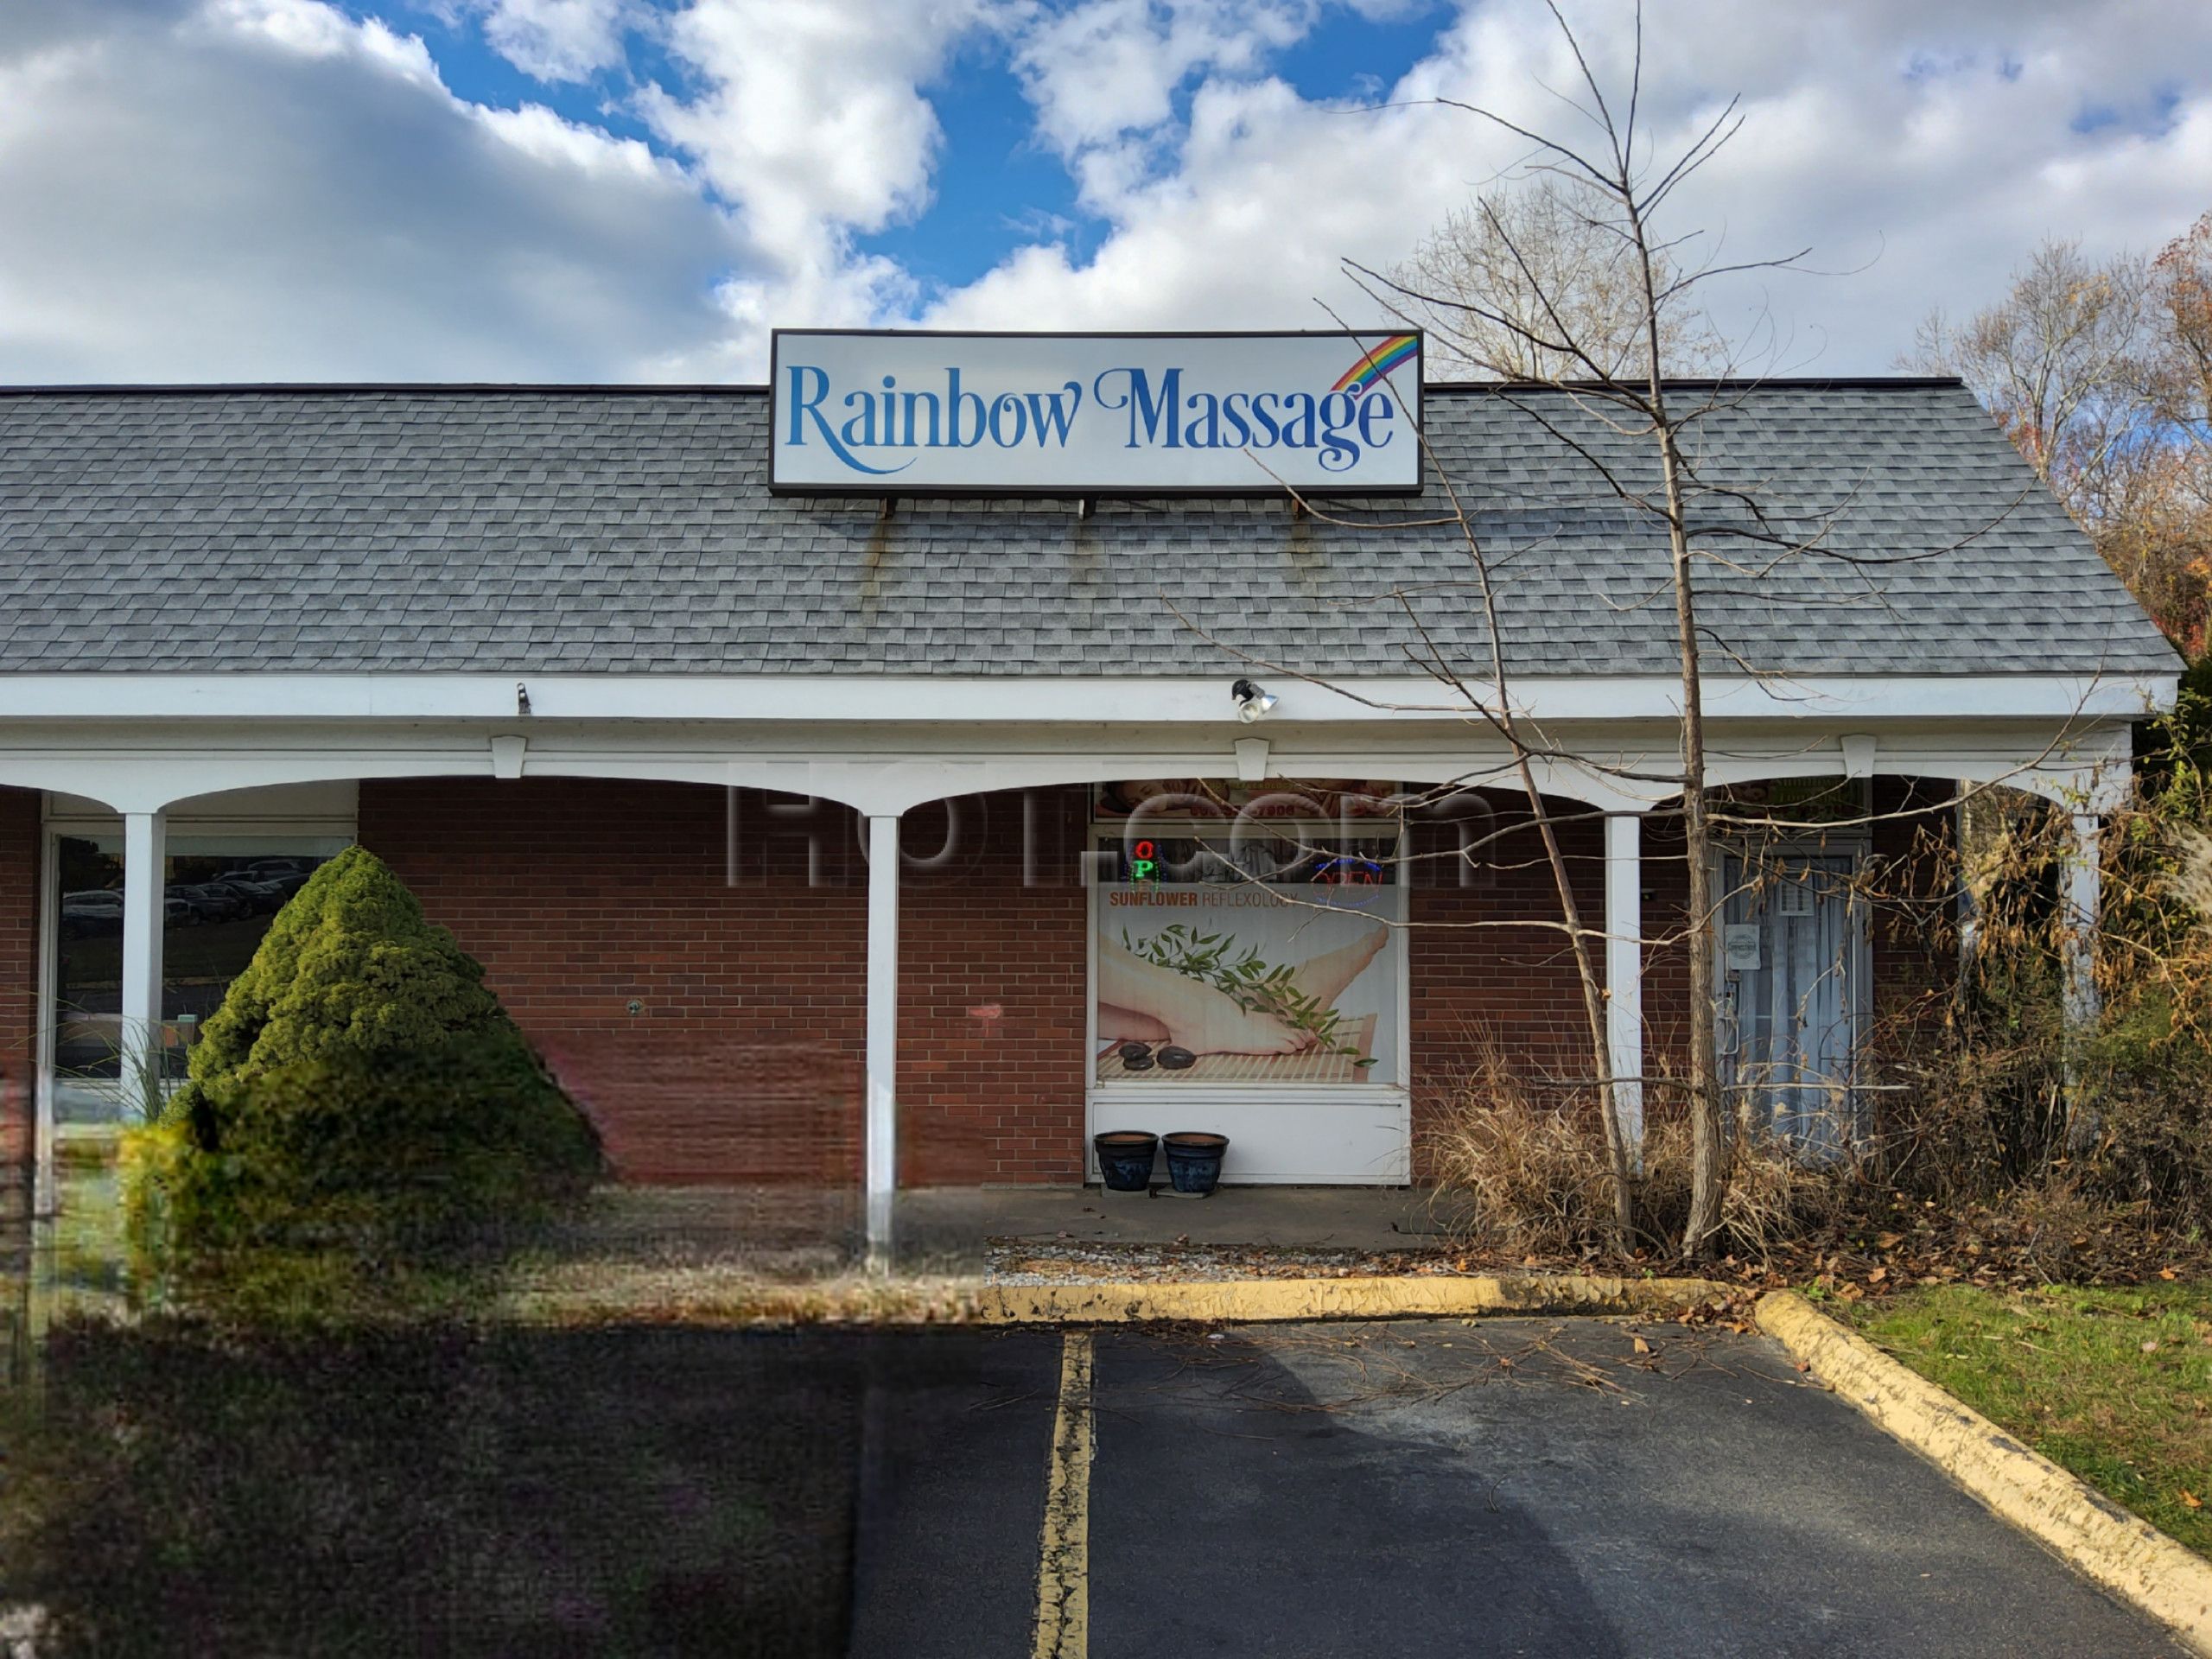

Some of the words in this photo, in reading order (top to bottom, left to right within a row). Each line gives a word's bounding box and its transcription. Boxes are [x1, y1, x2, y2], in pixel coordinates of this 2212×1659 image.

[785, 365, 1082, 474] Rainbow
[1094, 368, 1394, 472] Massage
[1109, 892, 1198, 906] SUNFLOWER
